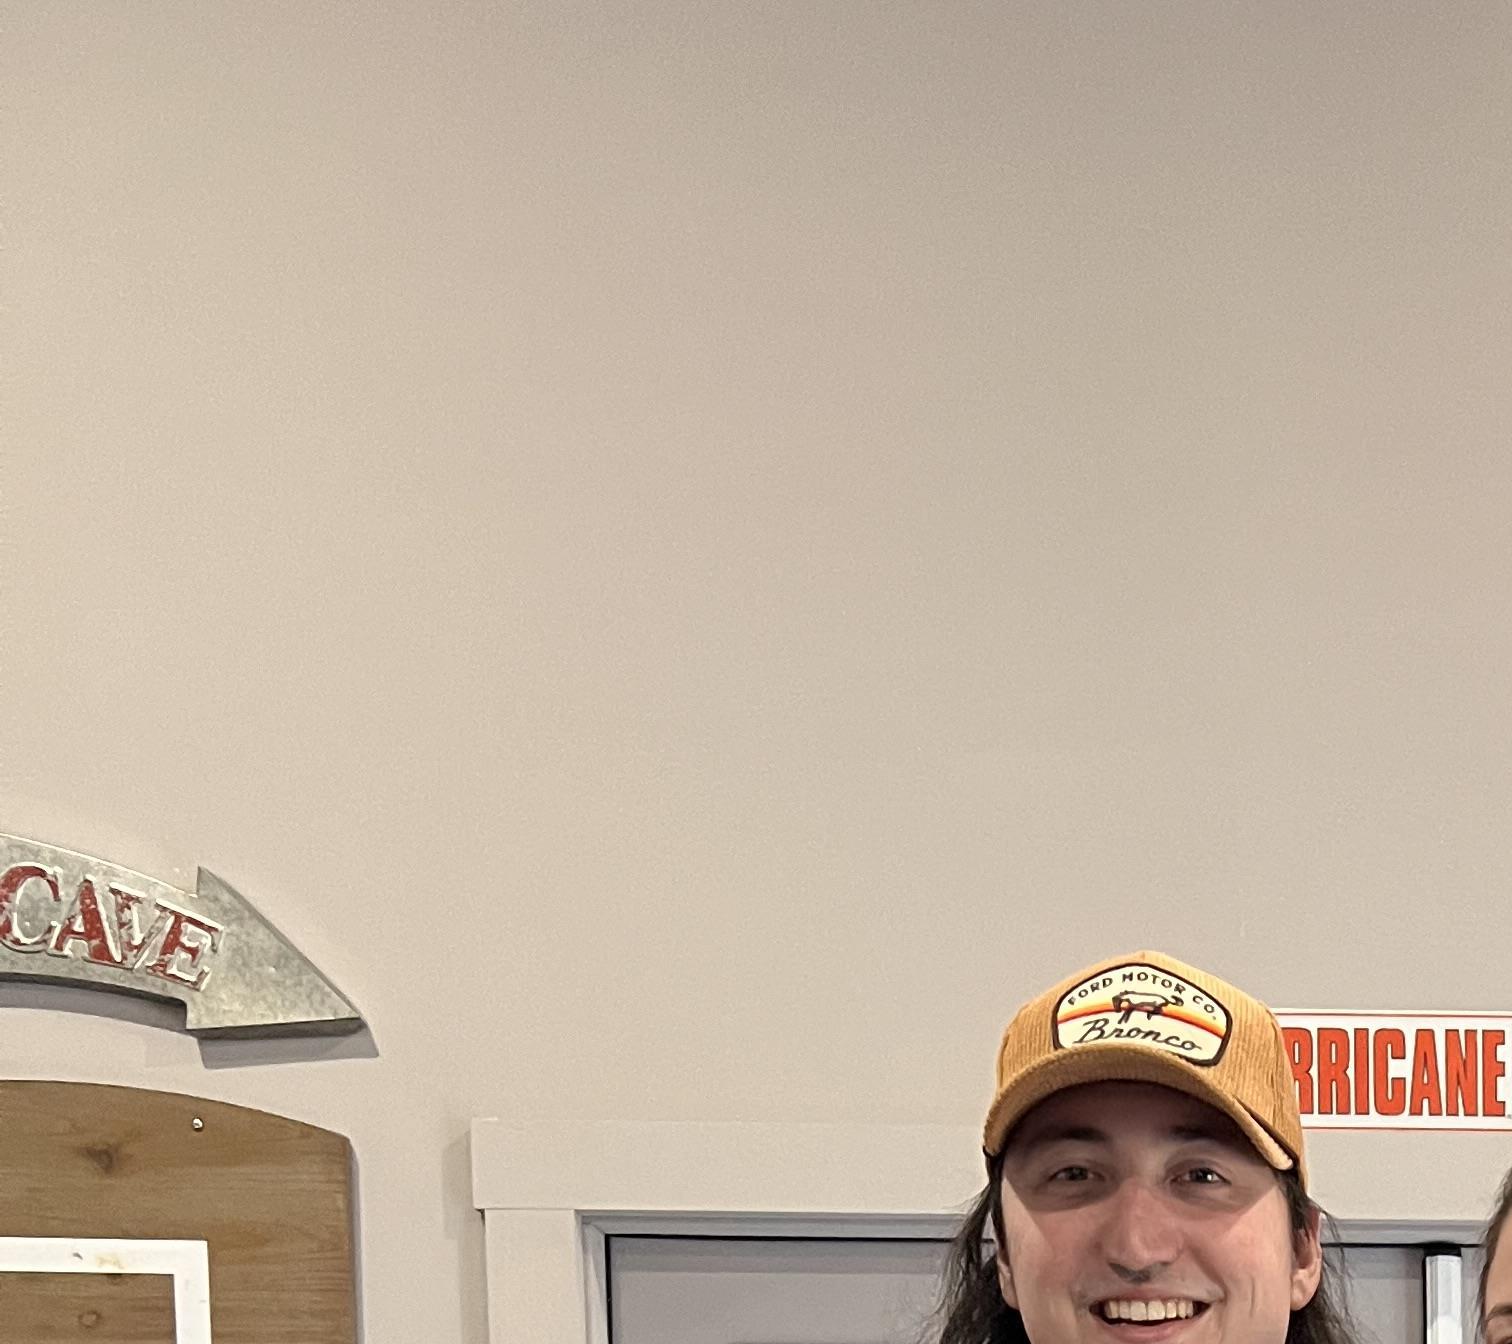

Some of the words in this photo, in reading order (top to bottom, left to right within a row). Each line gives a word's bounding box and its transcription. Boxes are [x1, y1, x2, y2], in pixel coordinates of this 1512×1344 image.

[0, 861, 224, 991] CAVE
[1067, 977, 1114, 1006] FORD
[1121, 971, 1187, 996] MOTOR
[1192, 994, 1218, 1021] CO.
[1072, 1018, 1203, 1051] Bronco
[1281, 1027, 1506, 1117] RRICANE
